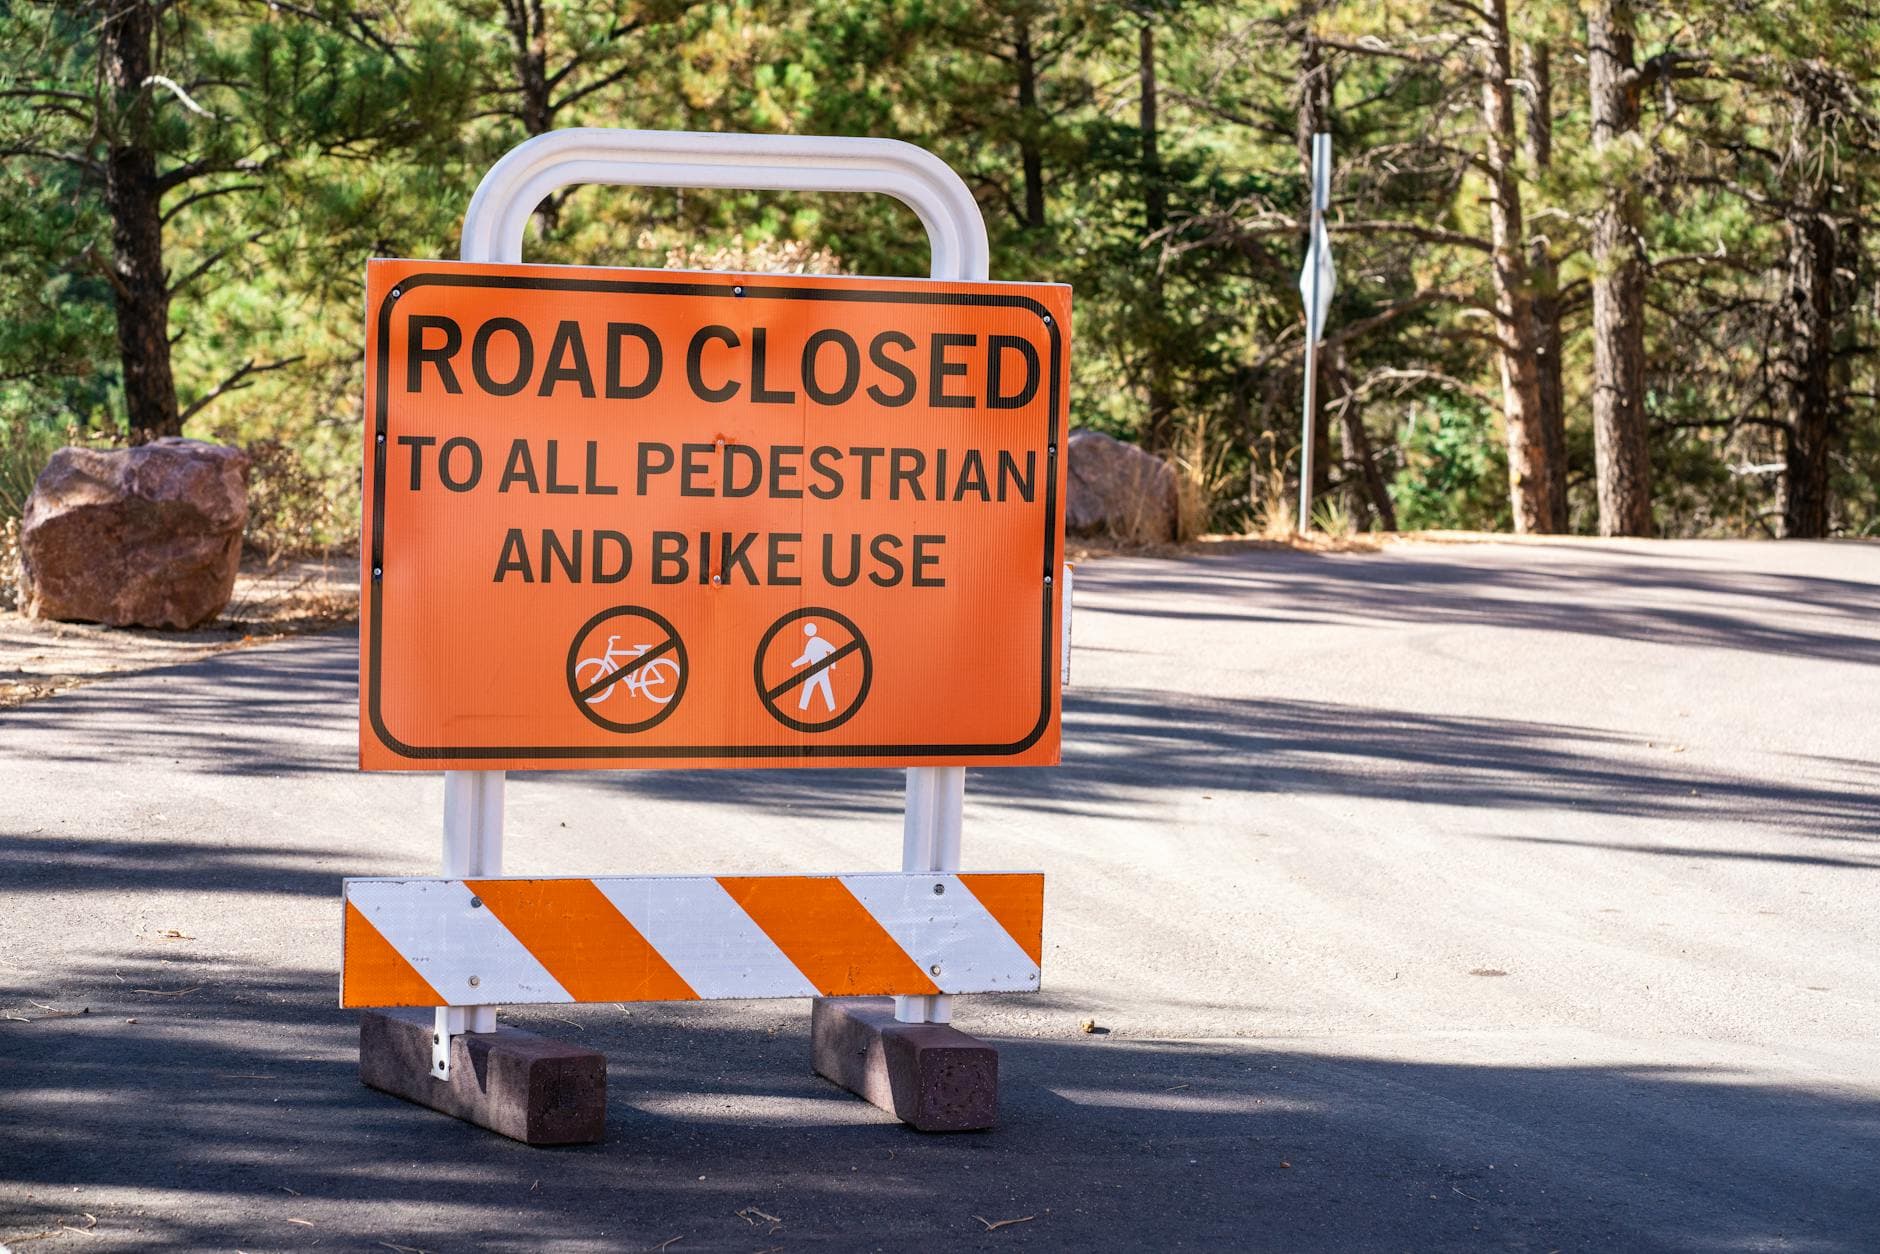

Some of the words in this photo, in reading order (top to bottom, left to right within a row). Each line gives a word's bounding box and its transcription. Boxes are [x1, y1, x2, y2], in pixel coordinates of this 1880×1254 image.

[407, 315, 663, 399] ROAD
[687, 325, 1040, 409] CLOSED
[398, 436, 482, 492] TO
[499, 439, 617, 494] ALL
[637, 443, 1035, 502] PEDESTRIAN
[494, 529, 632, 583] AND
[652, 532, 801, 585] BIKE
[823, 534, 945, 587] USE
